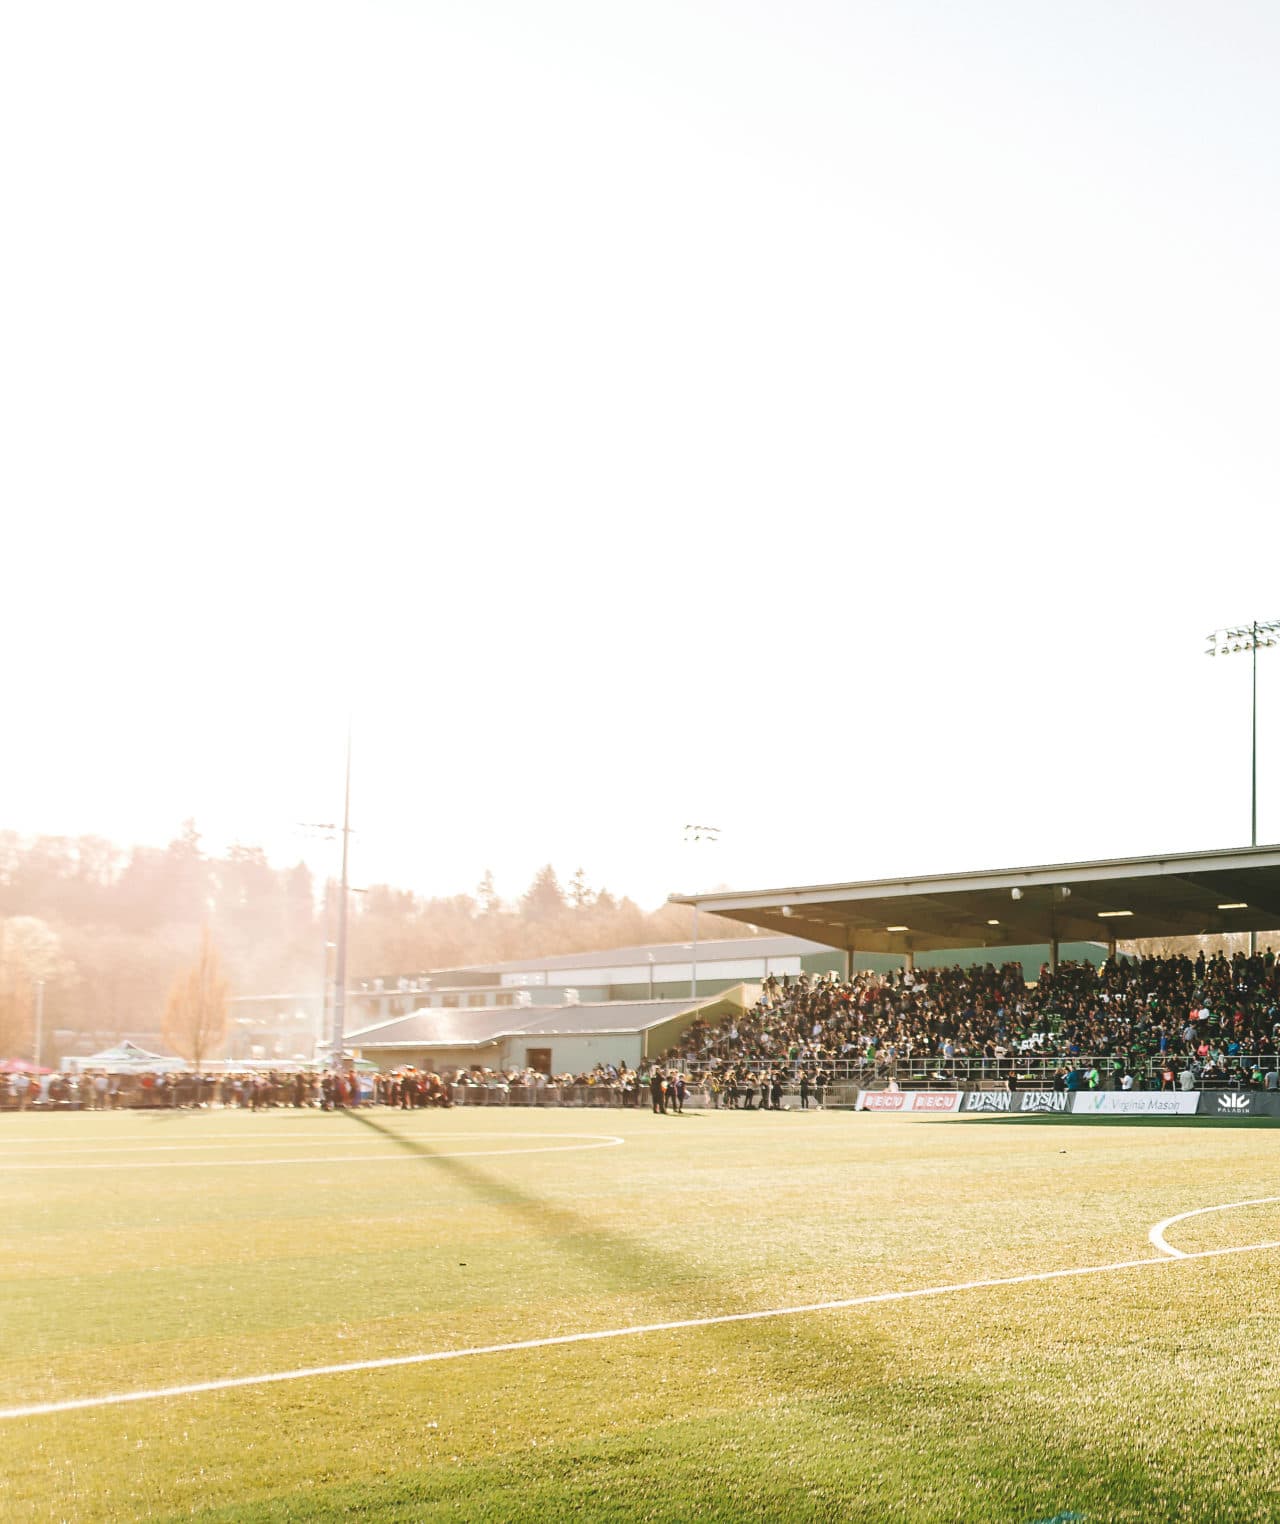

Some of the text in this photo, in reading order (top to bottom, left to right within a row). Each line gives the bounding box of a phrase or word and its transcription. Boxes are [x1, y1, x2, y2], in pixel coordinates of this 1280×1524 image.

[966, 1091, 1012, 1111] ELYSIAN
[1021, 1091, 1068, 1111] ELYSIAN
[1148, 1100, 1180, 1110] Mason
